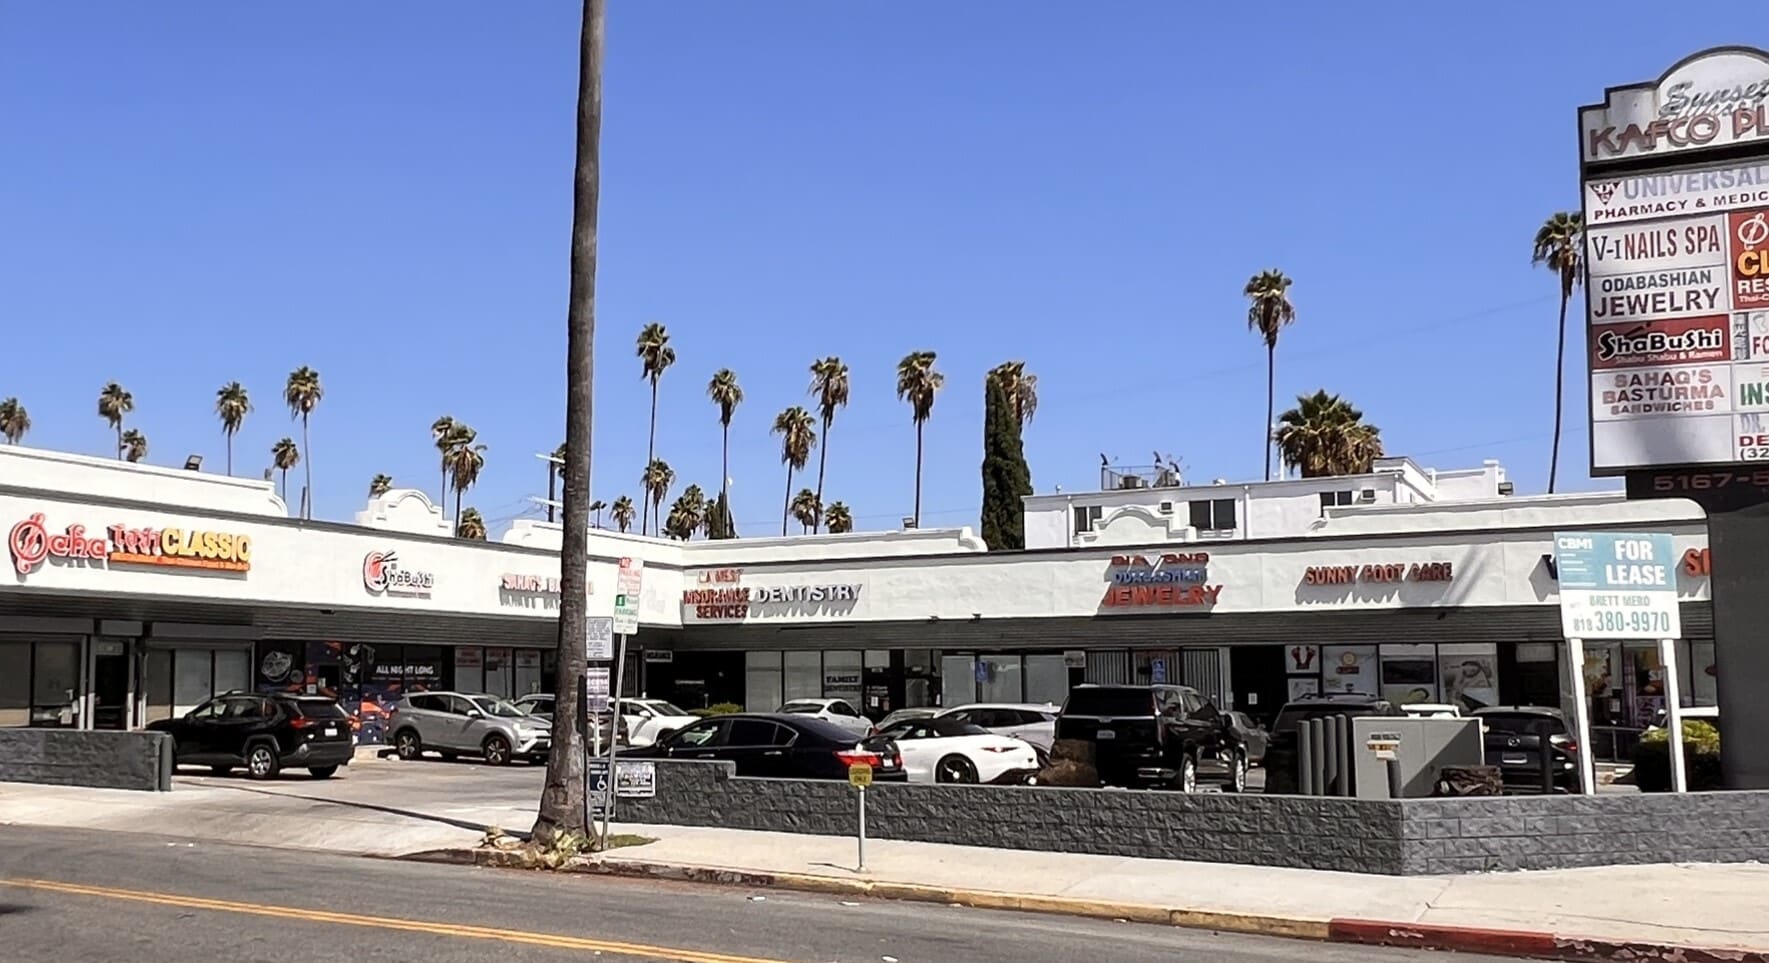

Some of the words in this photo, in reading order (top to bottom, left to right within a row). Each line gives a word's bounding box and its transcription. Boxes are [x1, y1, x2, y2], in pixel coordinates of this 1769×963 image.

[1589, 112, 1721, 157] KAFCO
[1624, 165, 1769, 200] UNIVERSAL
[1594, 199, 1688, 220] PHARMACY
[1695, 198, 1706, 208] &
[1713, 191, 1769, 207] MEDIC
[1624, 228, 1677, 261] NAILS
[1684, 224, 1721, 255] SPA
[1602, 270, 1712, 293] ODABASHIAN
[1594, 287, 1721, 317] JEWELRY
[1600, 328, 1722, 360] ShaBuShi
[1614, 369, 1713, 389] SAHAG'S
[1602, 384, 1725, 405] BASTURMA
[1611, 400, 1714, 415] SANDWICHES
[1615, 540, 1653, 561] FOR
[1305, 566, 1358, 585] SUNNY
[1363, 563, 1404, 583] FOOT
[1410, 562, 1453, 582] CARE
[1605, 564, 1667, 585] LEASE
[757, 584, 863, 603] DENTISTRY
[1103, 585, 1223, 607] JEWELRY
[1589, 595, 1619, 606] BRETT
[696, 604, 748, 619] SERVICES
[376, 665, 389, 674] ALL
[415, 665, 434, 675] LONG
